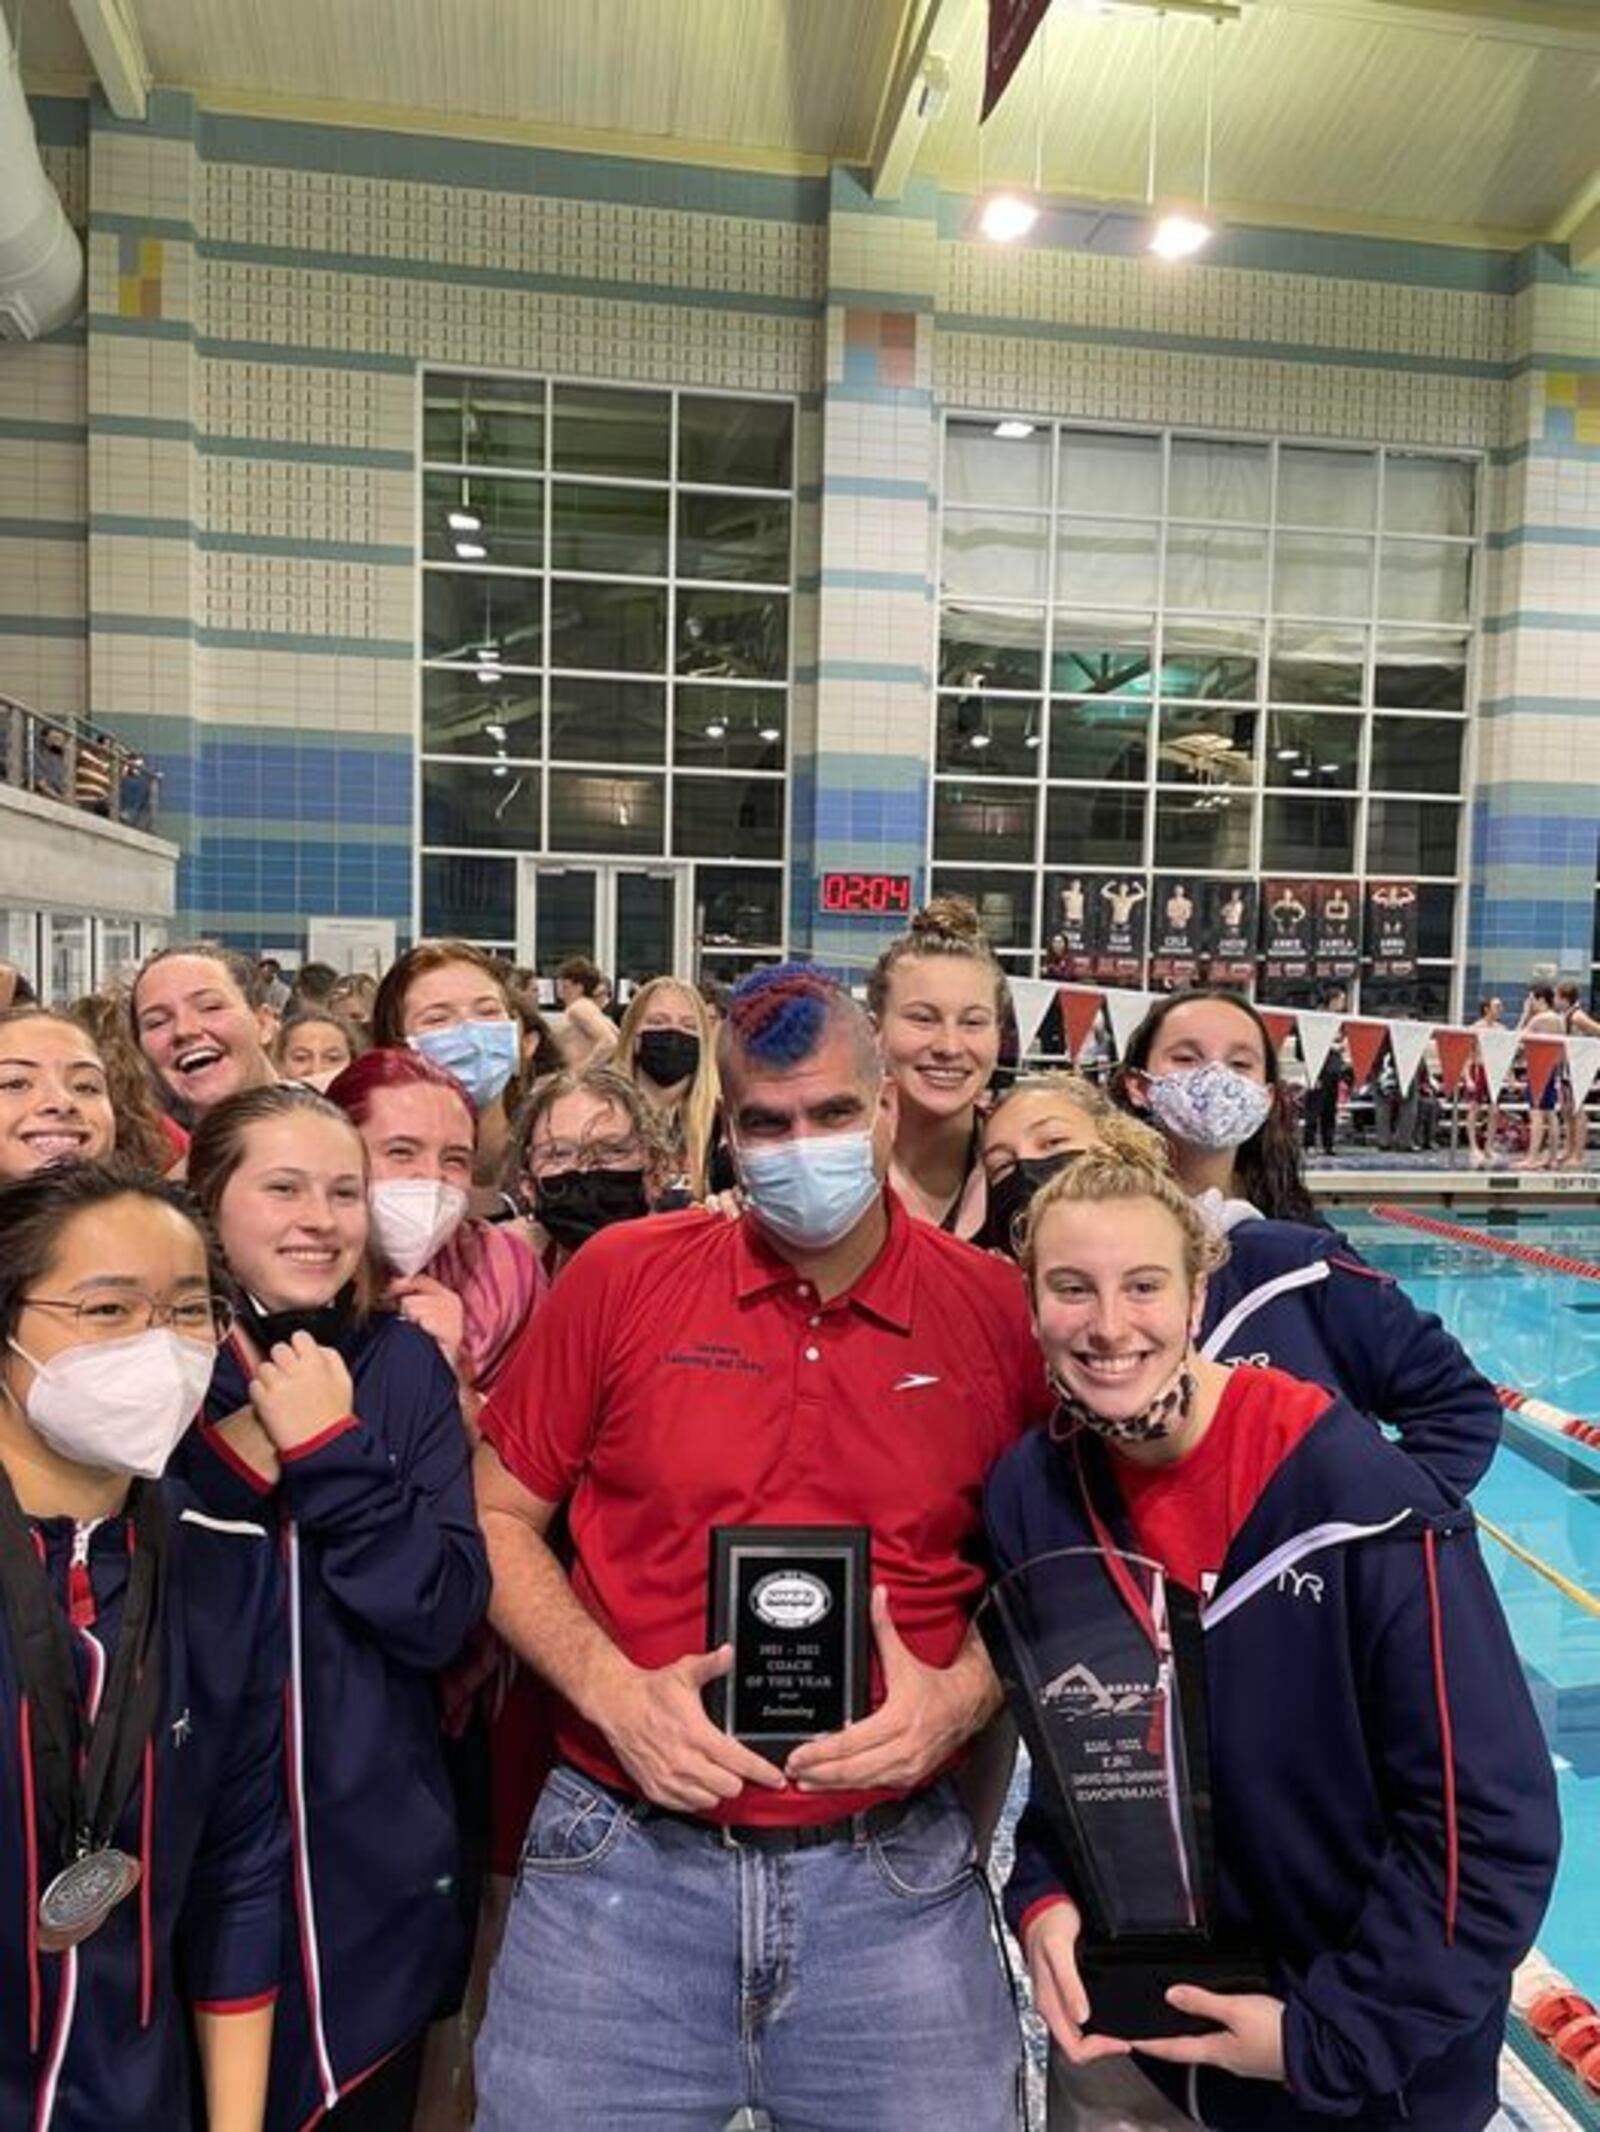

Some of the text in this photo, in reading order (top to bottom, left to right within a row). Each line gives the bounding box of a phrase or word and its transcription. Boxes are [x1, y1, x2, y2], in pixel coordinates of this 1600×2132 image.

[825, 875, 908, 909] 02:04
[1277, 1568, 1324, 1604] TYR
[766, 1659, 813, 1672] COACH
[745, 1675, 832, 1688] OF THE YEAR
